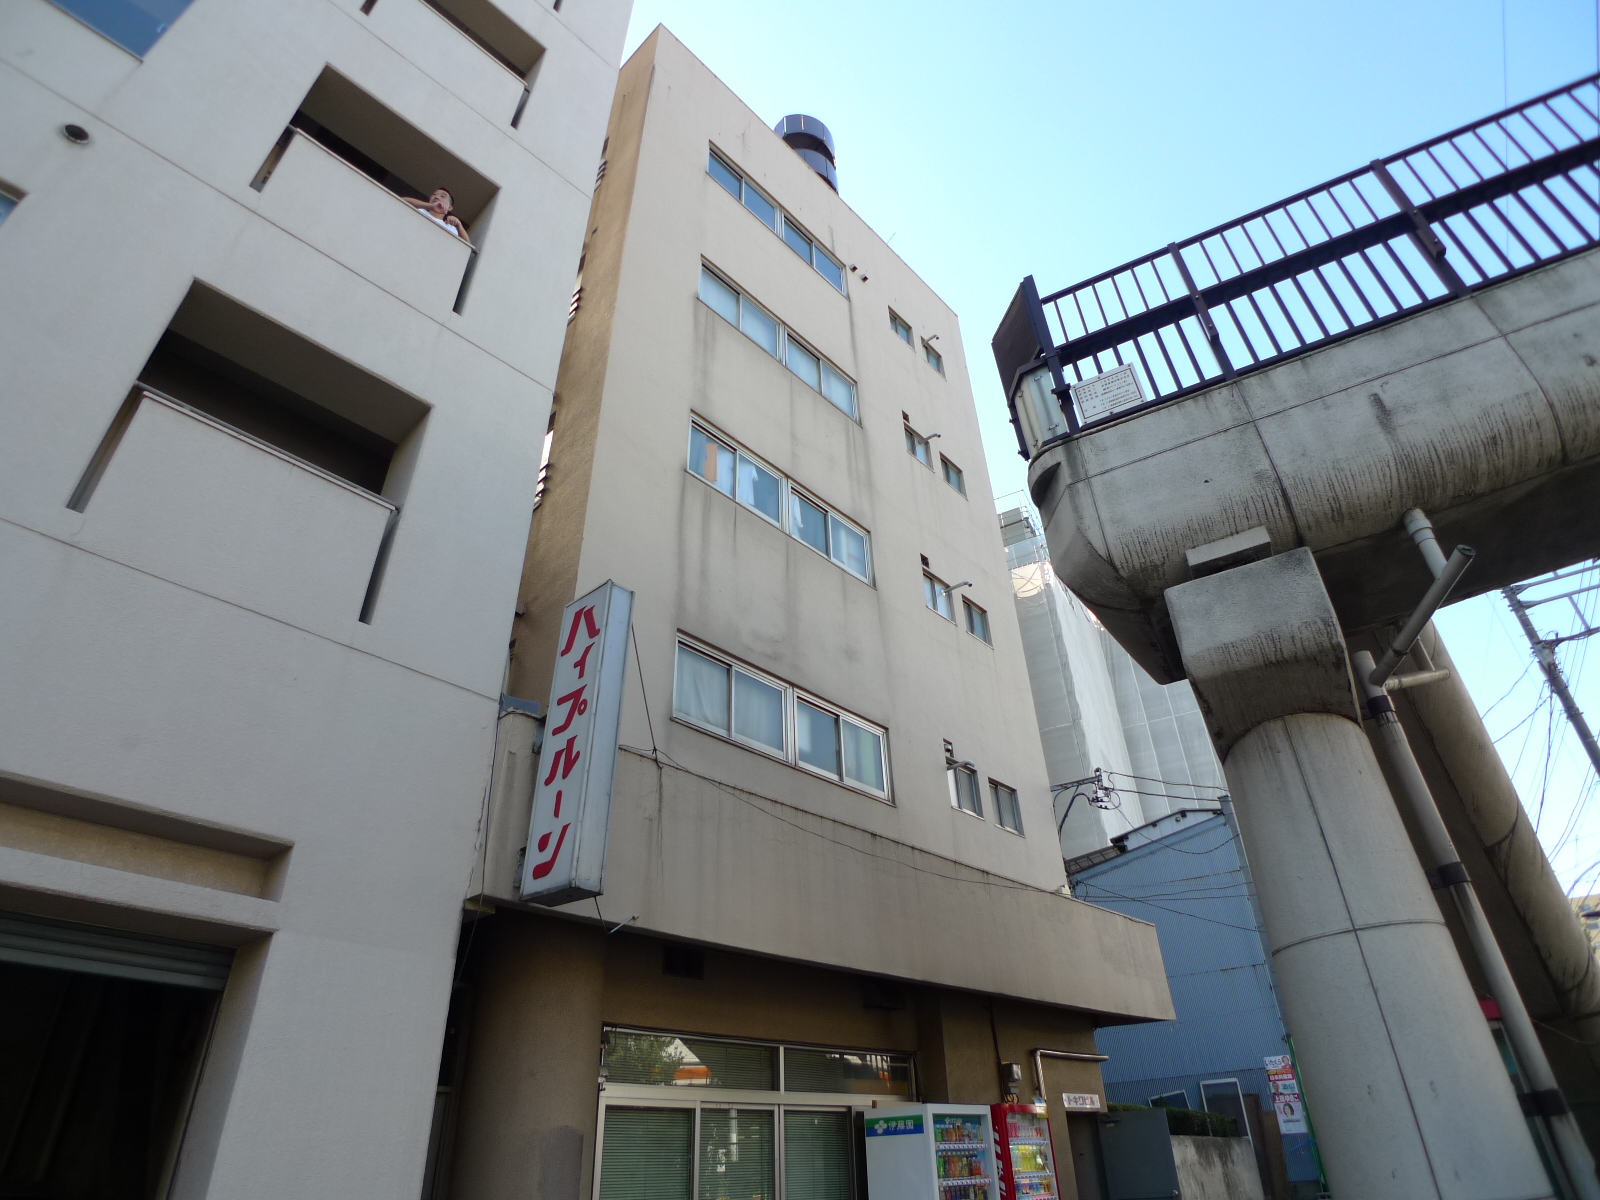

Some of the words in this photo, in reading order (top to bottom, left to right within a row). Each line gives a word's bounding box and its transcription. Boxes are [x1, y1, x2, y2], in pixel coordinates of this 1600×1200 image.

[532, 605, 600, 880] ハイプルーン
[1067, 1096, 1095, 1106] トキワビル
[888, 1119, 915, 1131] 伊藤園
